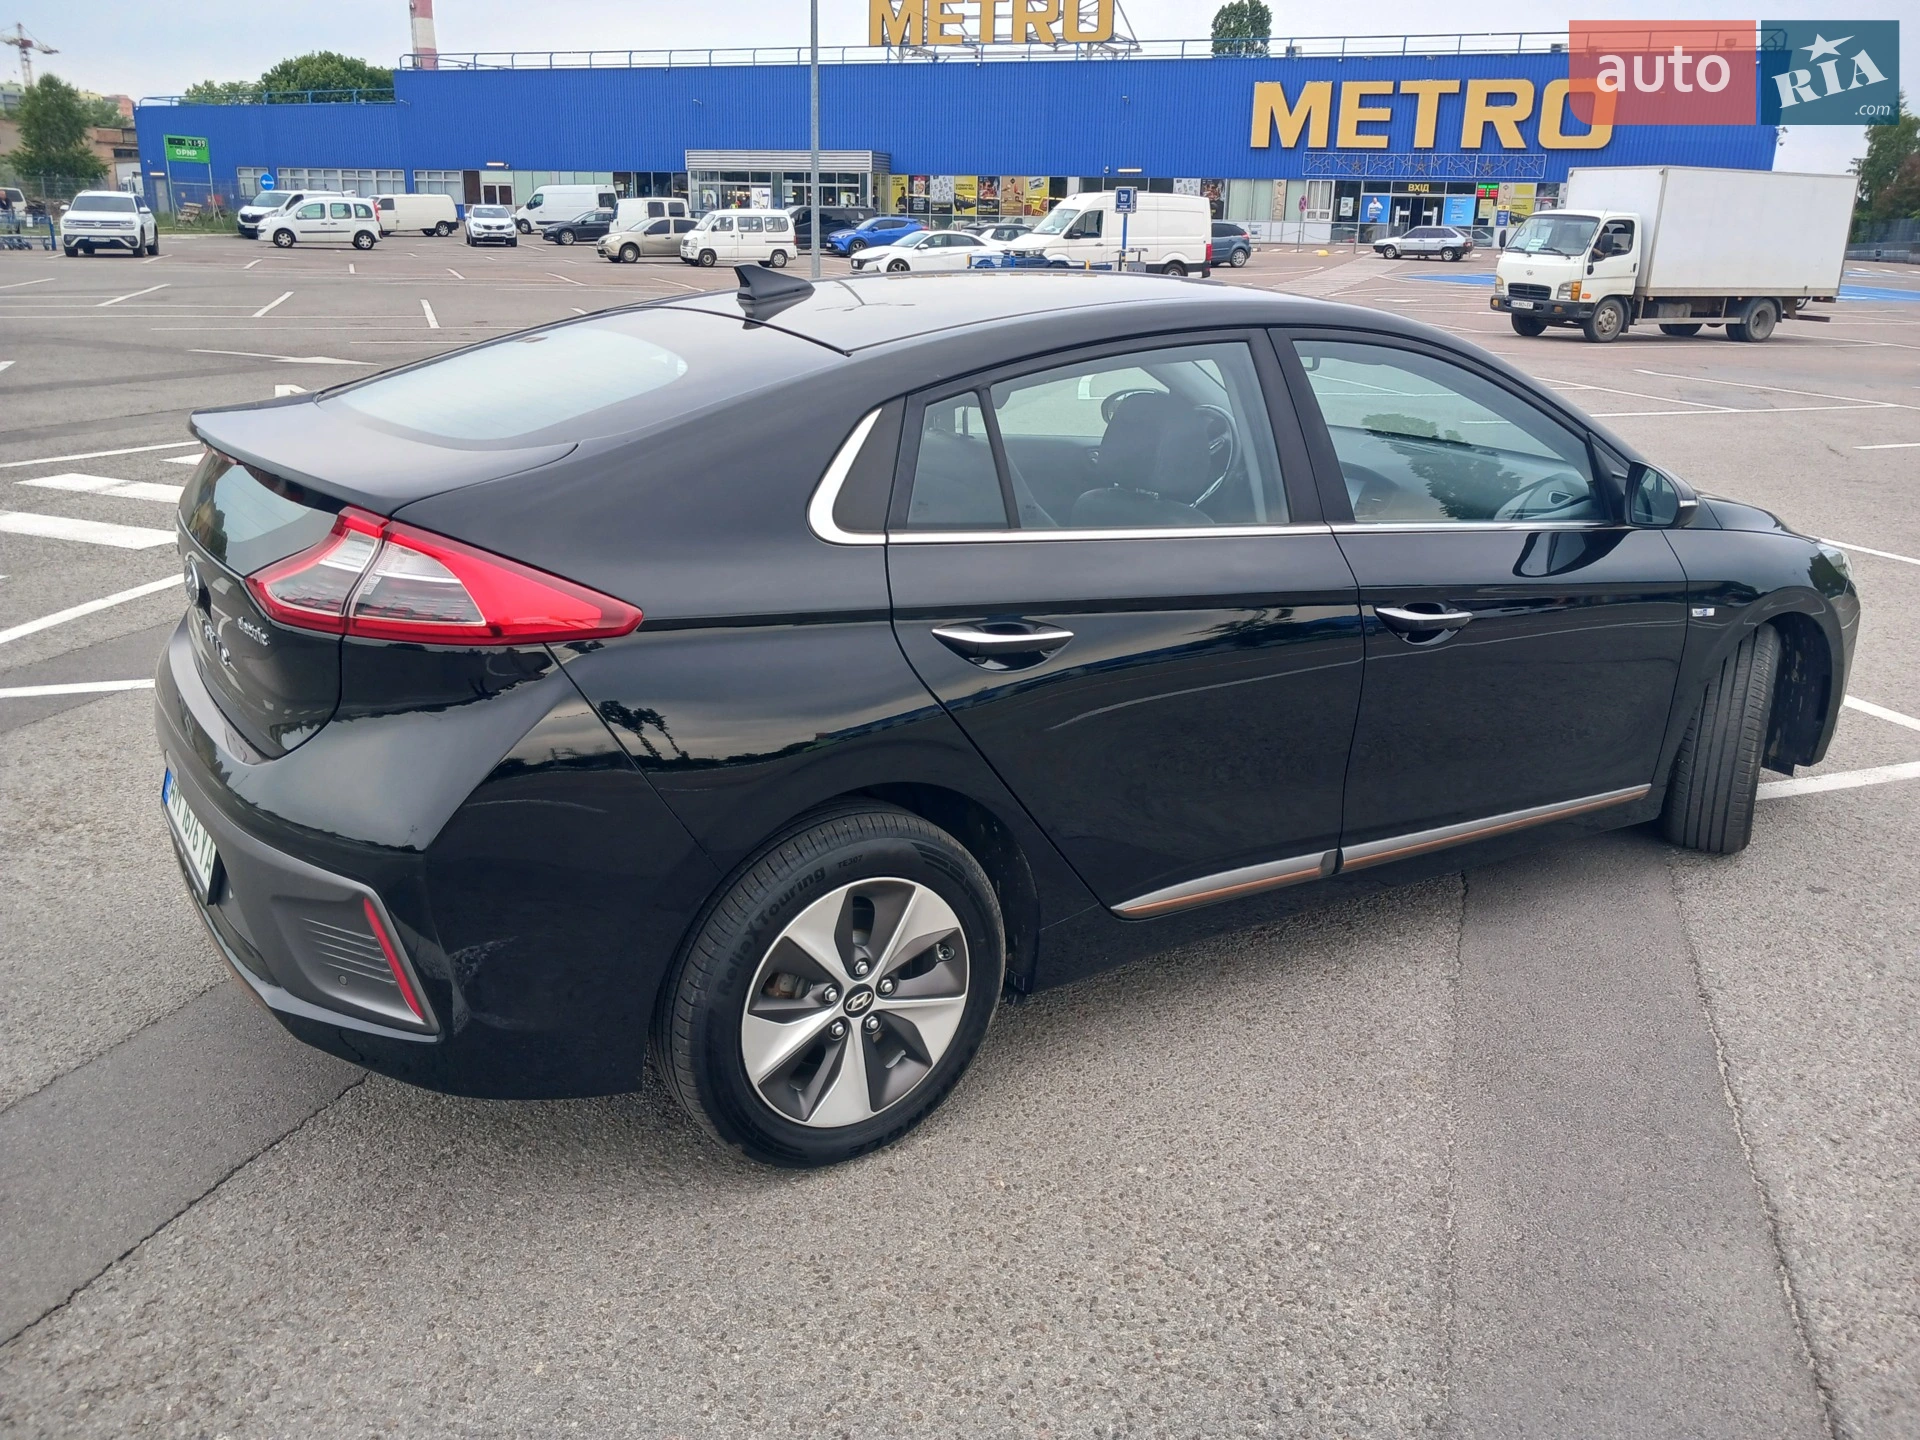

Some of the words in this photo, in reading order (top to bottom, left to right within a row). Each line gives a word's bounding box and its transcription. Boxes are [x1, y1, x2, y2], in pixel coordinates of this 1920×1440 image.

[869, 0, 1114, 46] METRO
[1250, 79, 1619, 150] METRO
[755, 866, 826, 926] Touring
